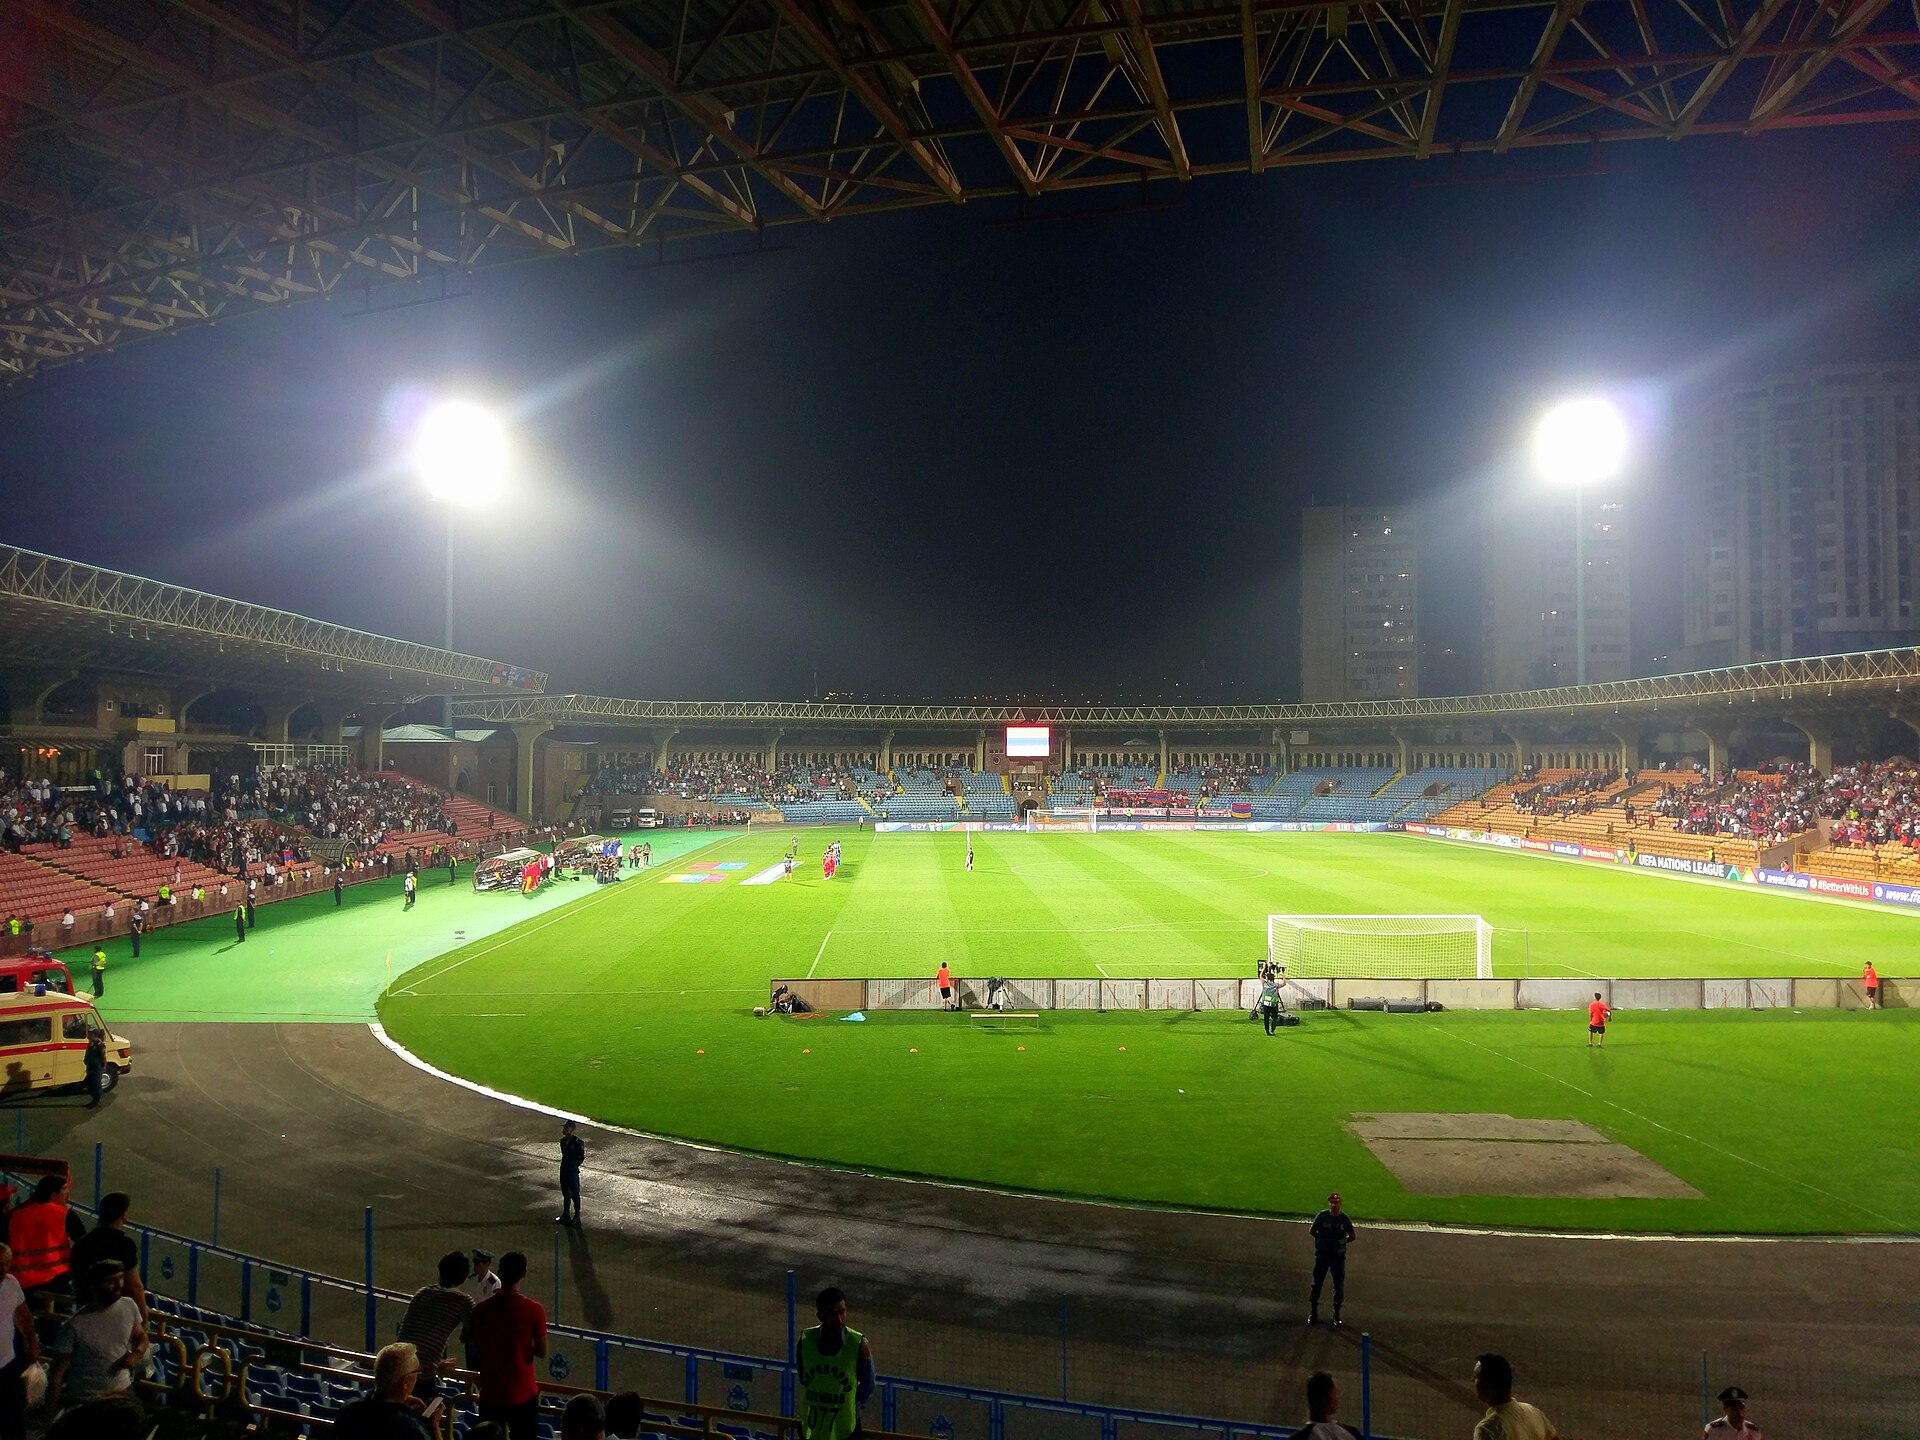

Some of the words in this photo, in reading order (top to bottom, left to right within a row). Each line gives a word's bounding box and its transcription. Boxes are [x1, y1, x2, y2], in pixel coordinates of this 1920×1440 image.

[1638, 854, 1657, 867] UEFA
[1657, 858, 1691, 872] NATIONS
[1693, 863, 1725, 876] LEAGUE
[1766, 874, 1809, 887] www.ffa.am
[1817, 880, 1869, 896] #BetterWithUs
[808, 1404, 840, 1432] 077
